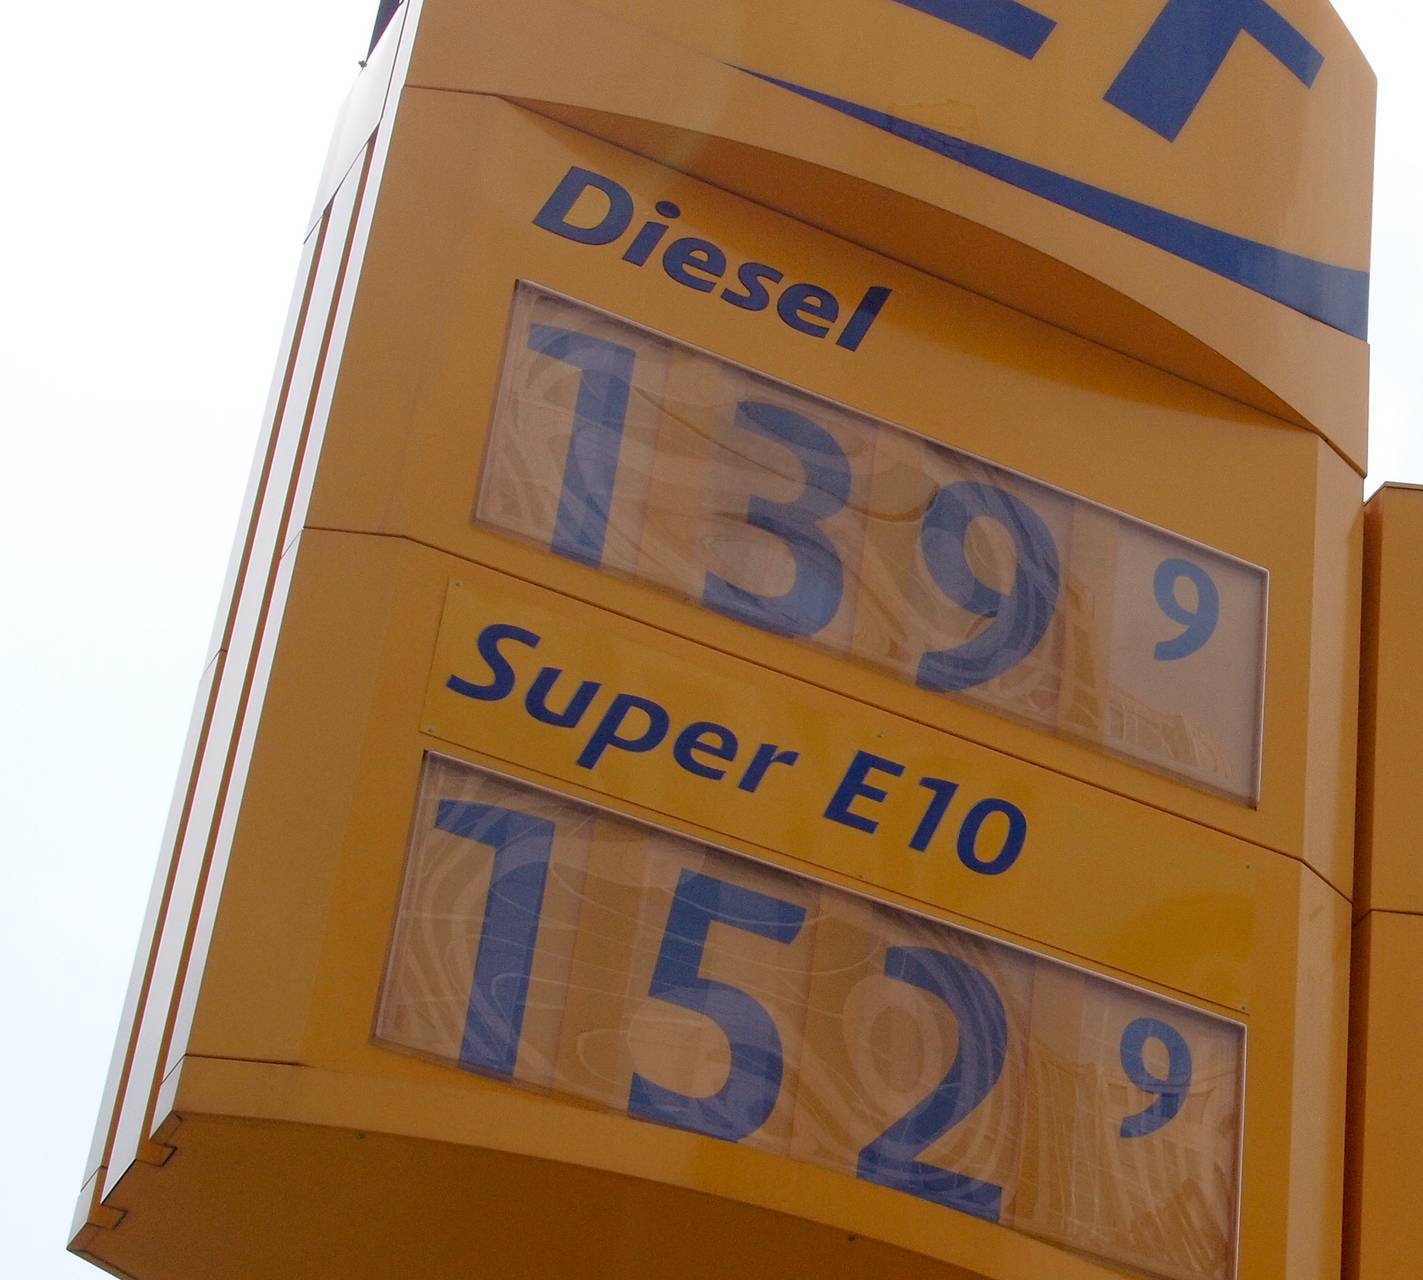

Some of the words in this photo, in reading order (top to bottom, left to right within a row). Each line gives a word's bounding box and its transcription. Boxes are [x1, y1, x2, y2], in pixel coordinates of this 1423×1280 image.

[532, 165, 891, 353] Diesel
[445, 622, 799, 794] Super
[822, 750, 1028, 876] E10
